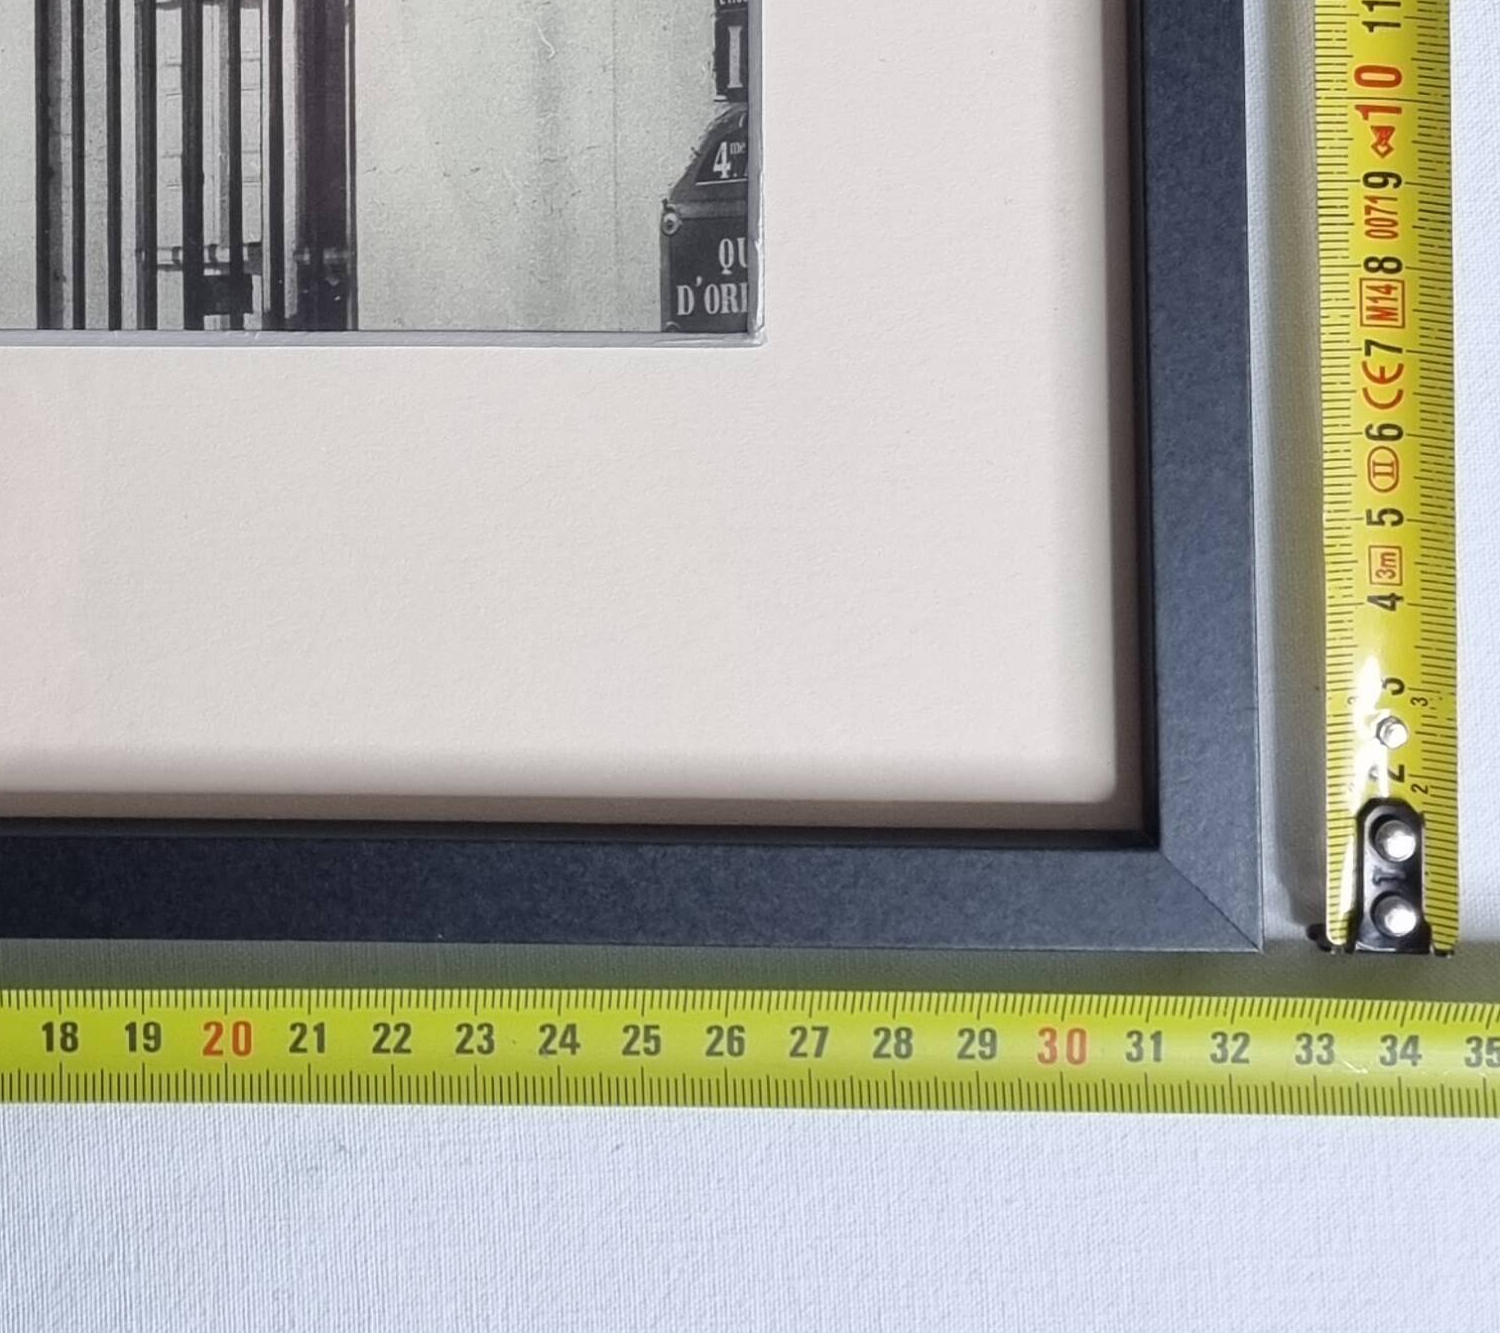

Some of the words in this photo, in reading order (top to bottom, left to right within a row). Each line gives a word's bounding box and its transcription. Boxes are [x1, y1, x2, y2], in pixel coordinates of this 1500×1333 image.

[1361, 0, 1402, 33] 11
[1354, 65, 1403, 121] 10
[1362, 171, 1403, 189] 9
[1363, 195, 1399, 239] 0071
[1363, 256, 1403, 275] 8
[1365, 283, 1399, 323] M14
[1364, 339, 1403, 357] 7
[1361, 360, 1405, 410] CE
[1364, 423, 1404, 442] 6
[1366, 508, 1404, 527] 5
[1367, 592, 1404, 612] 4
[42, 1021, 79, 1053] 18
[125, 1021, 161, 1053] 19
[203, 1021, 252, 1057] 20
[289, 1022, 325, 1053] 21
[372, 1022, 412, 1054] 22
[455, 1022, 495, 1055] 23
[538, 1023, 581, 1058] 24
[622, 1024, 661, 1056] 25
[705, 1025, 745, 1057] 26
[789, 1025, 829, 1058] 27
[873, 1026, 913, 1060] 28
[957, 1027, 997, 1061] 29
[1038, 1027, 1086, 1065] 30
[1126, 1030, 1162, 1063] 31
[1210, 1031, 1250, 1064] 32
[1295, 1032, 1335, 1065] 33
[1380, 1034, 1422, 1067] 34
[1464, 1035, 1500, 1068] 35
